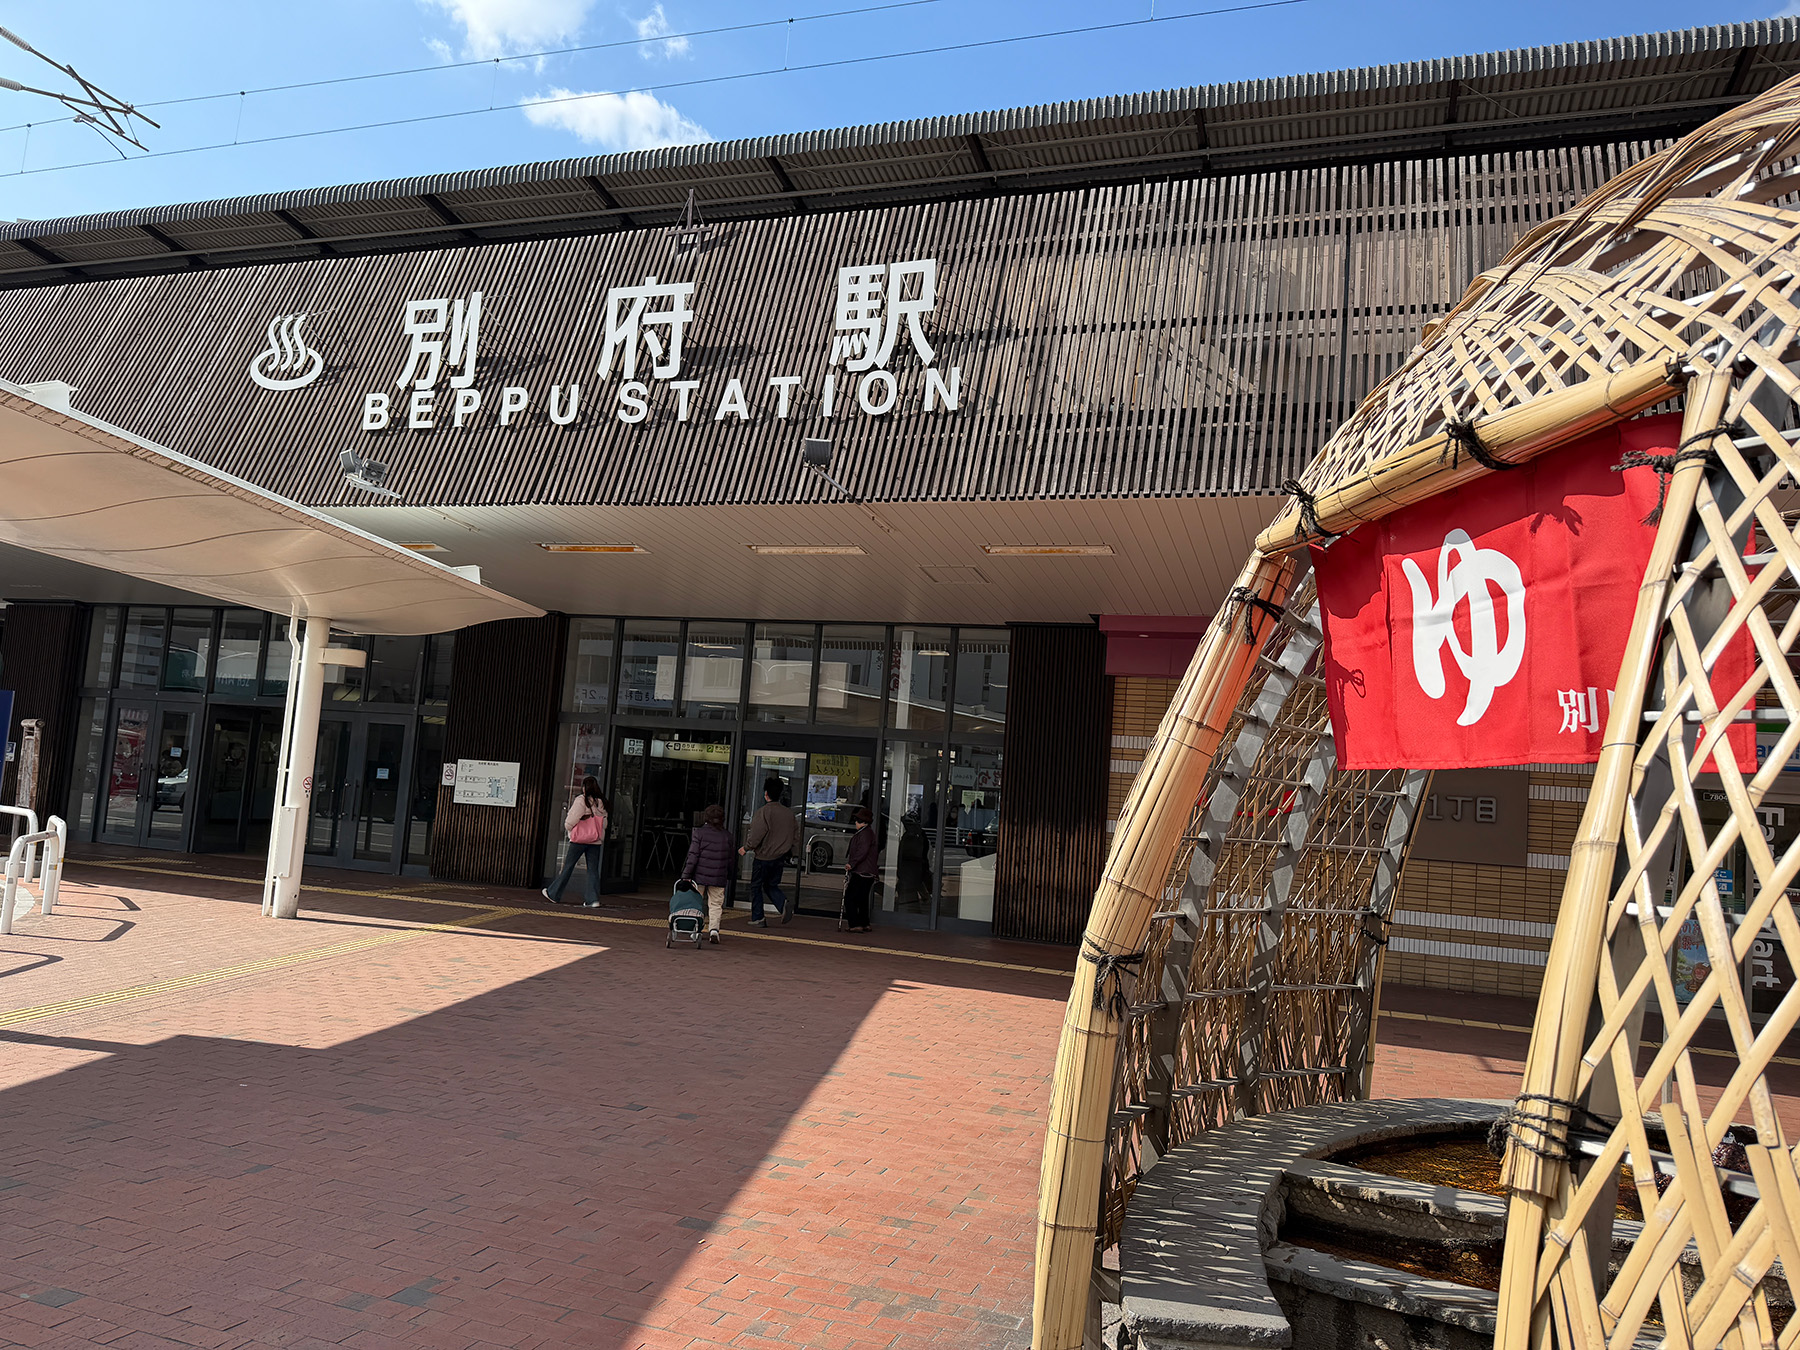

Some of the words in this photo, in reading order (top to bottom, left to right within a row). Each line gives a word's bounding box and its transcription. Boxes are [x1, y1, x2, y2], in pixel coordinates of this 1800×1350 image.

[397, 258, 938, 391] 別府駅
[362, 383, 580, 431] BEPPU
[619, 366, 962, 424] STATION
[1402, 528, 1526, 727] ゆ
[1557, 686, 1615, 735] 別
